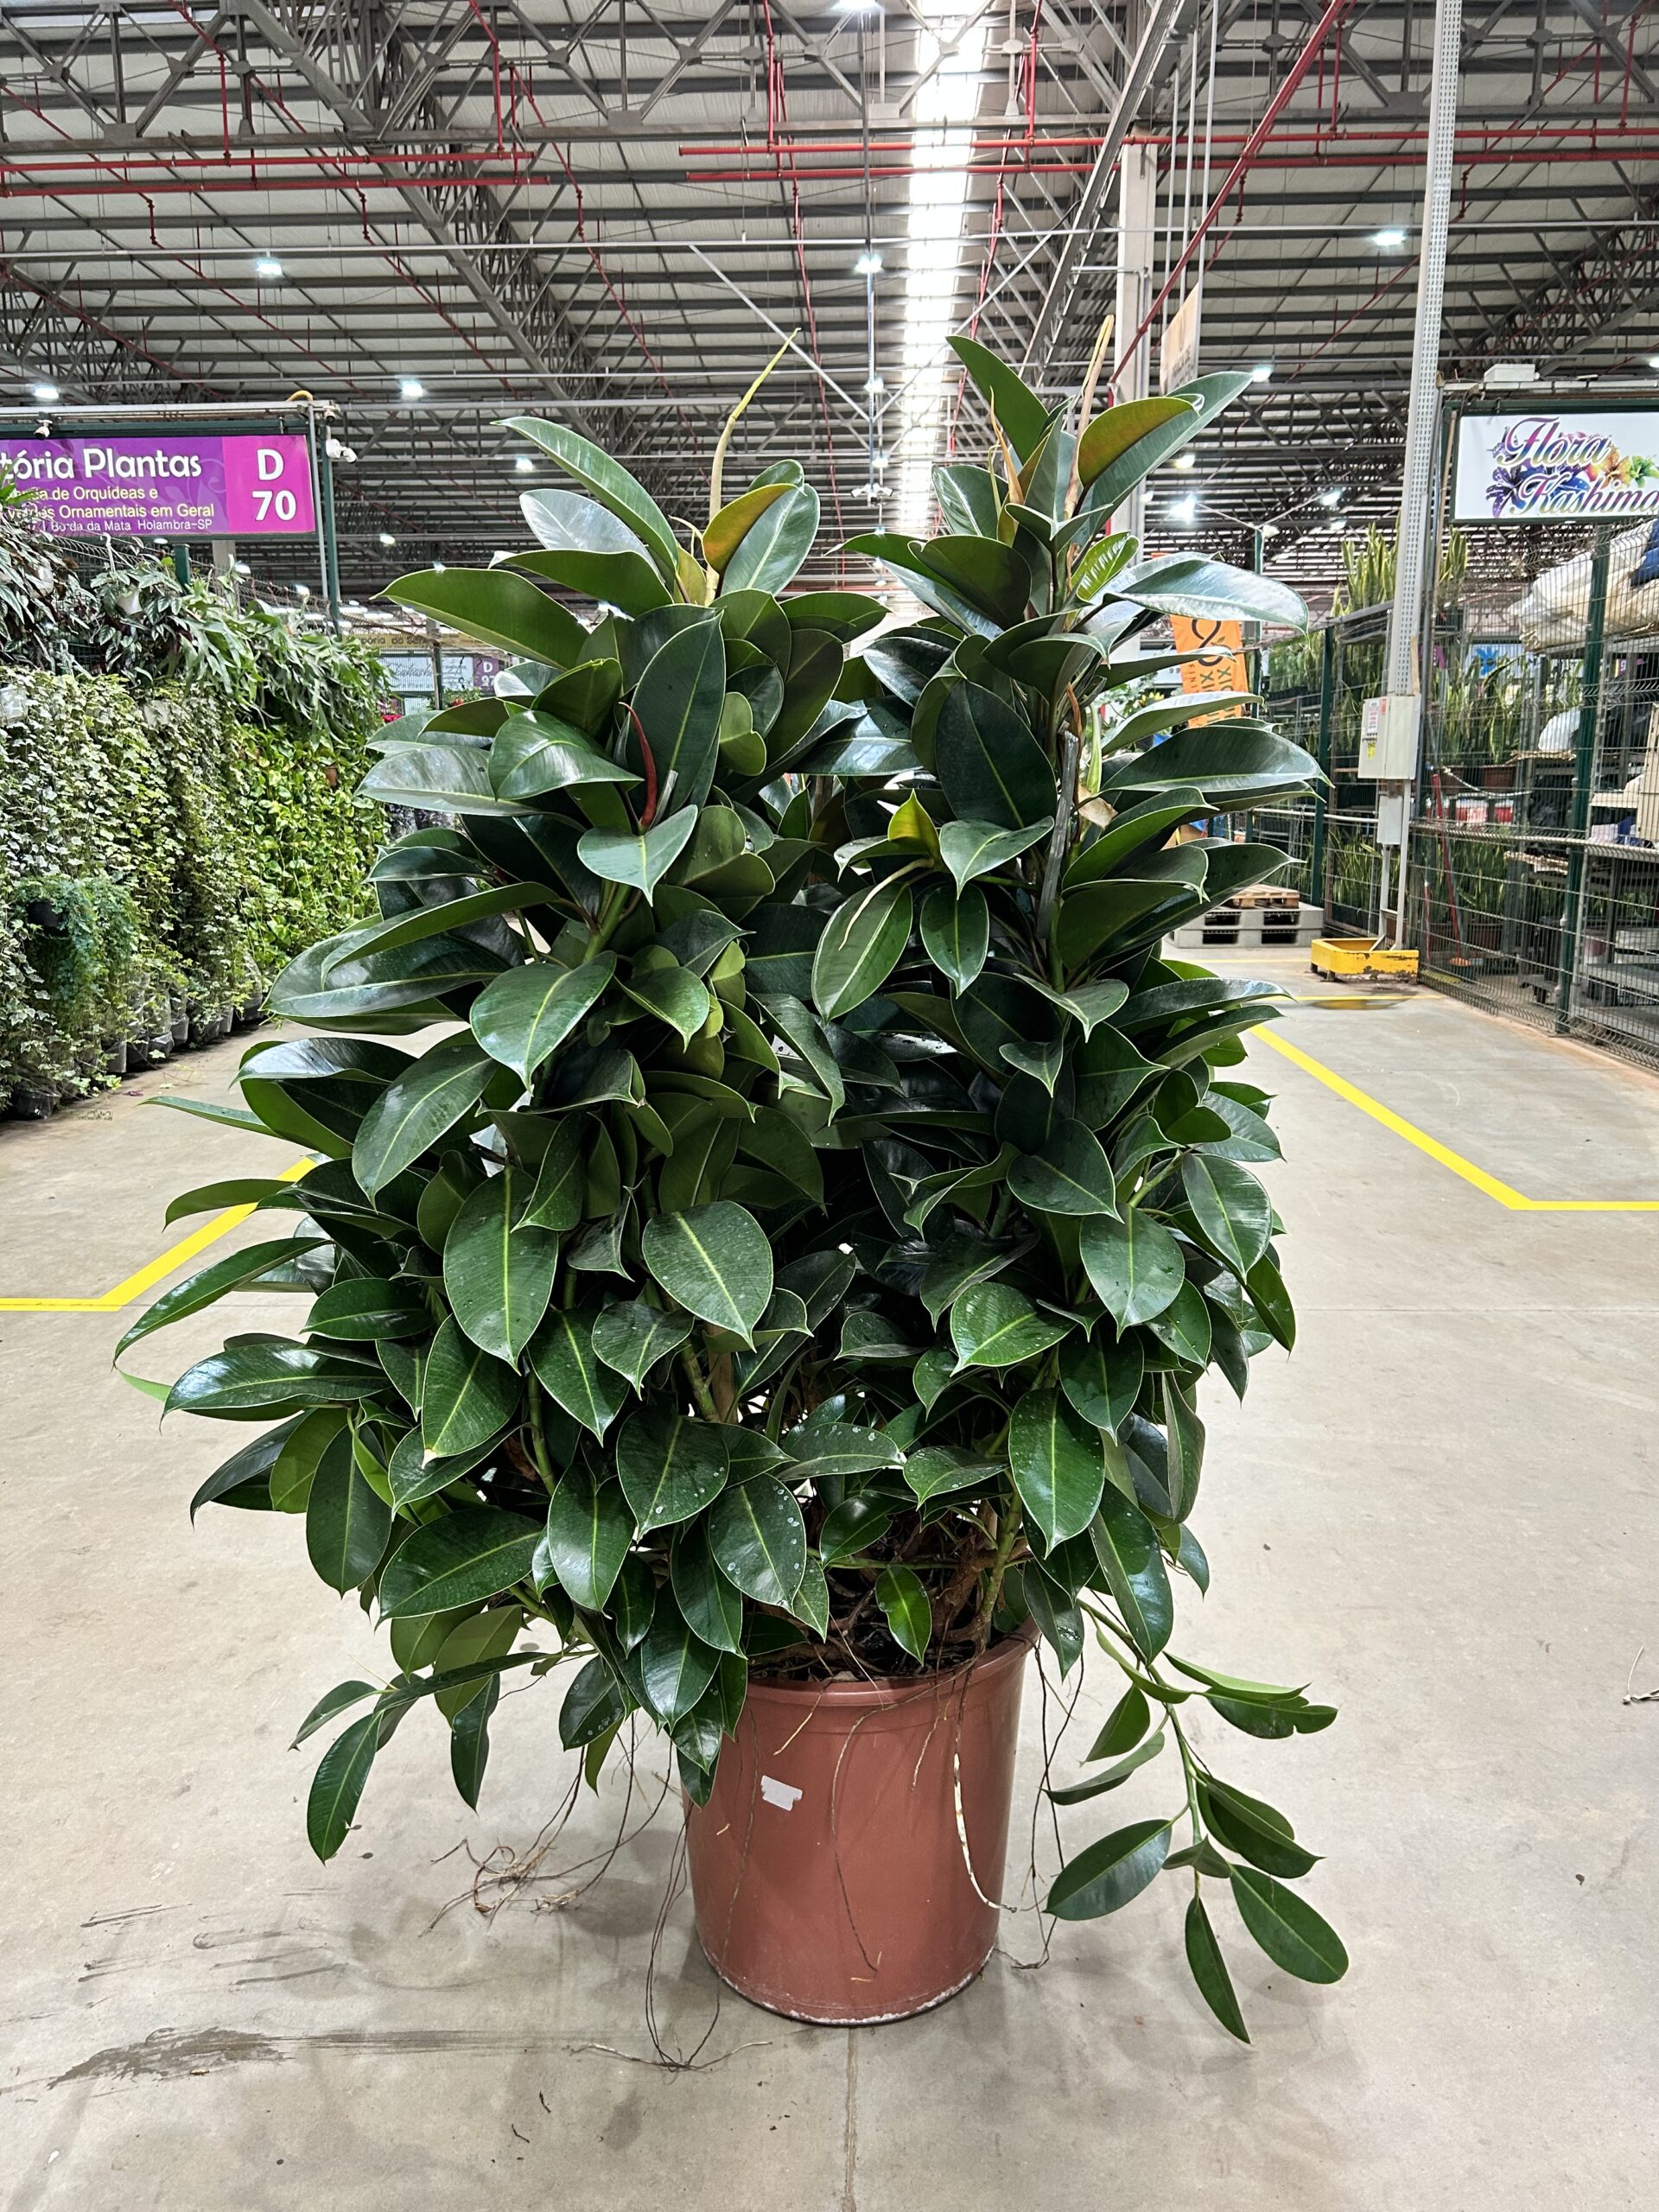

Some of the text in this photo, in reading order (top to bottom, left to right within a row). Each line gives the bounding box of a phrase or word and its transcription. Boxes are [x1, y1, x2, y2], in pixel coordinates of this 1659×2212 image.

[1496, 416, 1608, 467] Flora
[83, 448, 202, 478] Plantas
[257, 448, 284, 480] D
[52, 486, 70, 500] de
[73, 486, 146, 503] Orquídeas
[149, 488, 159, 499] e
[251, 489, 297, 521] 70
[59, 504, 148, 518] Ornamentais
[150, 507, 173, 518] em
[176, 503, 215, 518] Geral
[86, 520, 101, 531] da
[104, 520, 131, 531] Mata
[483, 661, 493, 673] D
